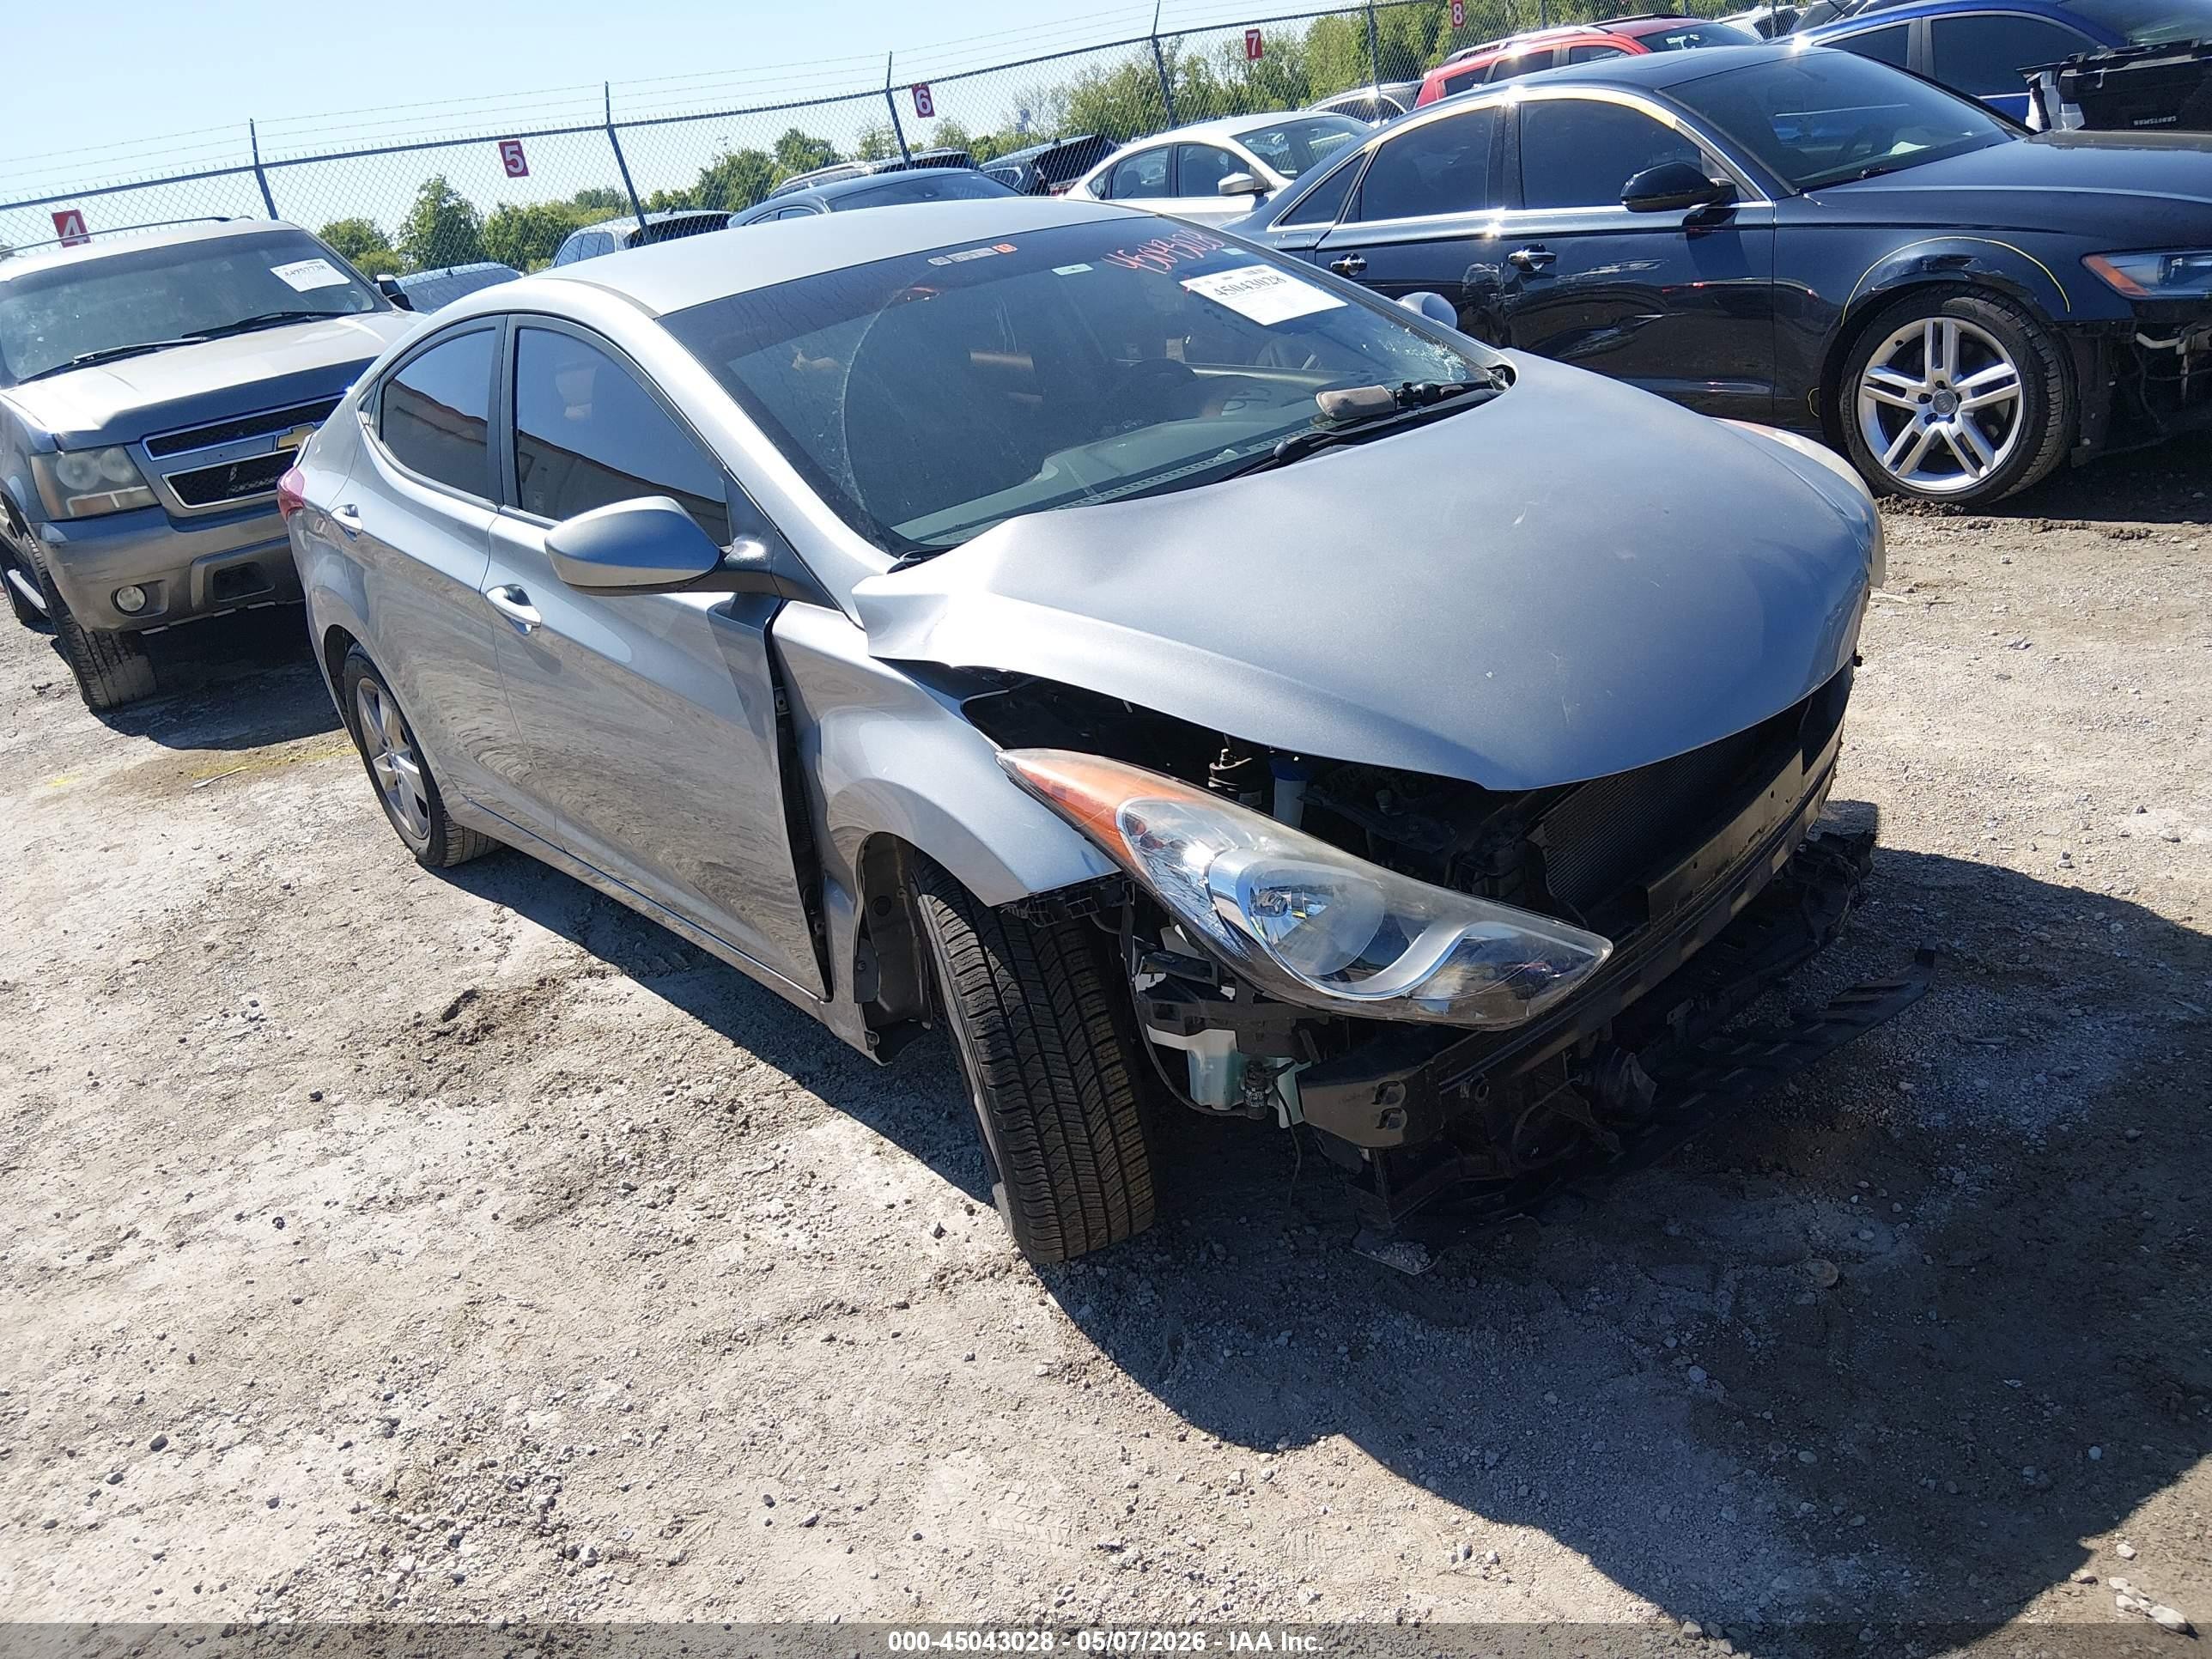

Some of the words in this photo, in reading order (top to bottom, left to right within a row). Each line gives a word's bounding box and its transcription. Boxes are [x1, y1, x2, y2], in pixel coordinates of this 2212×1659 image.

[1453, 3, 1463, 24] 8
[1248, 33, 1257, 56] 7
[916, 89, 932, 114] 6
[2134, 115, 2176, 126] CRAFTSMAN
[504, 145, 525, 173] 5
[61, 214, 88, 244] 4
[1213, 274, 1287, 297] 45043028
